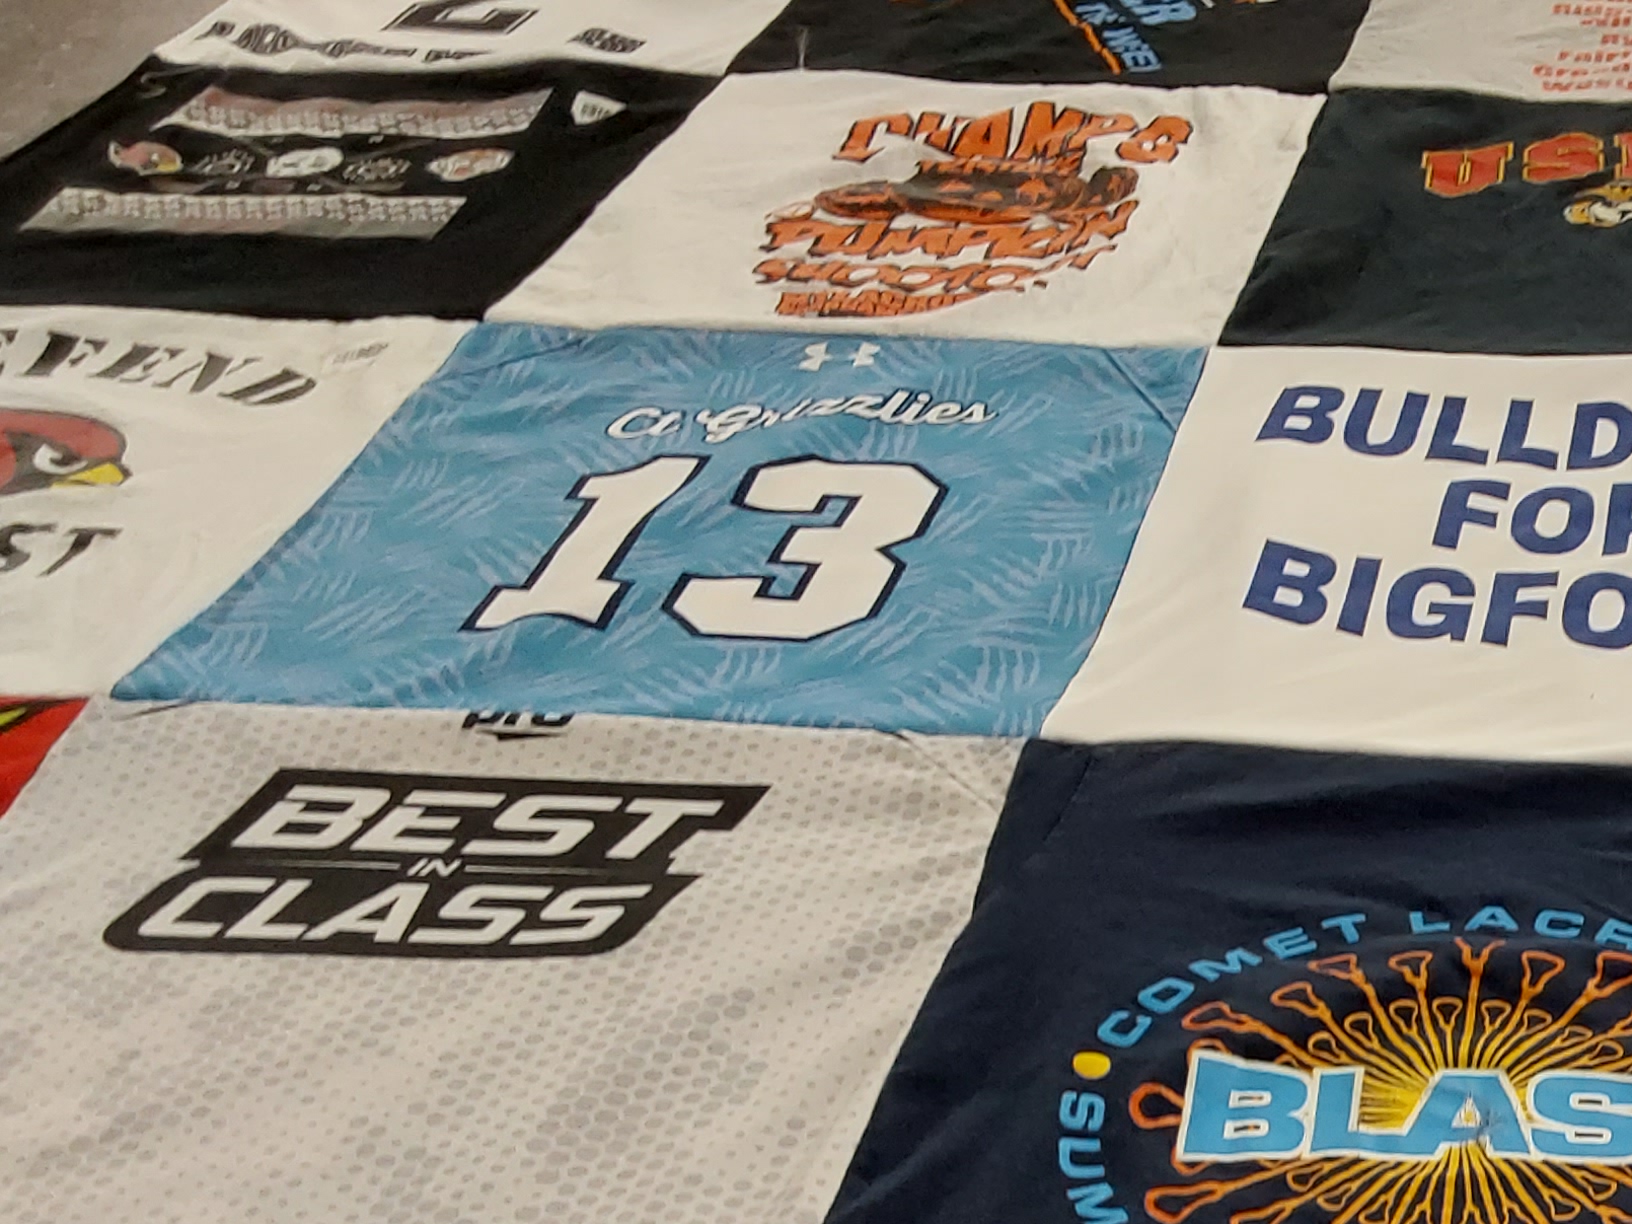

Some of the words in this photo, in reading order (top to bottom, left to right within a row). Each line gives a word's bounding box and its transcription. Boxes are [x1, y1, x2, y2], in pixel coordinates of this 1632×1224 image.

[0, 329, 317, 406] FEND
[458, 454, 950, 642] 13
[230, 784, 726, 860] BEST
[407, 856, 464, 878] IN
[137, 876, 653, 946] CLASS
[1095, 912, 1368, 1050] COMET
